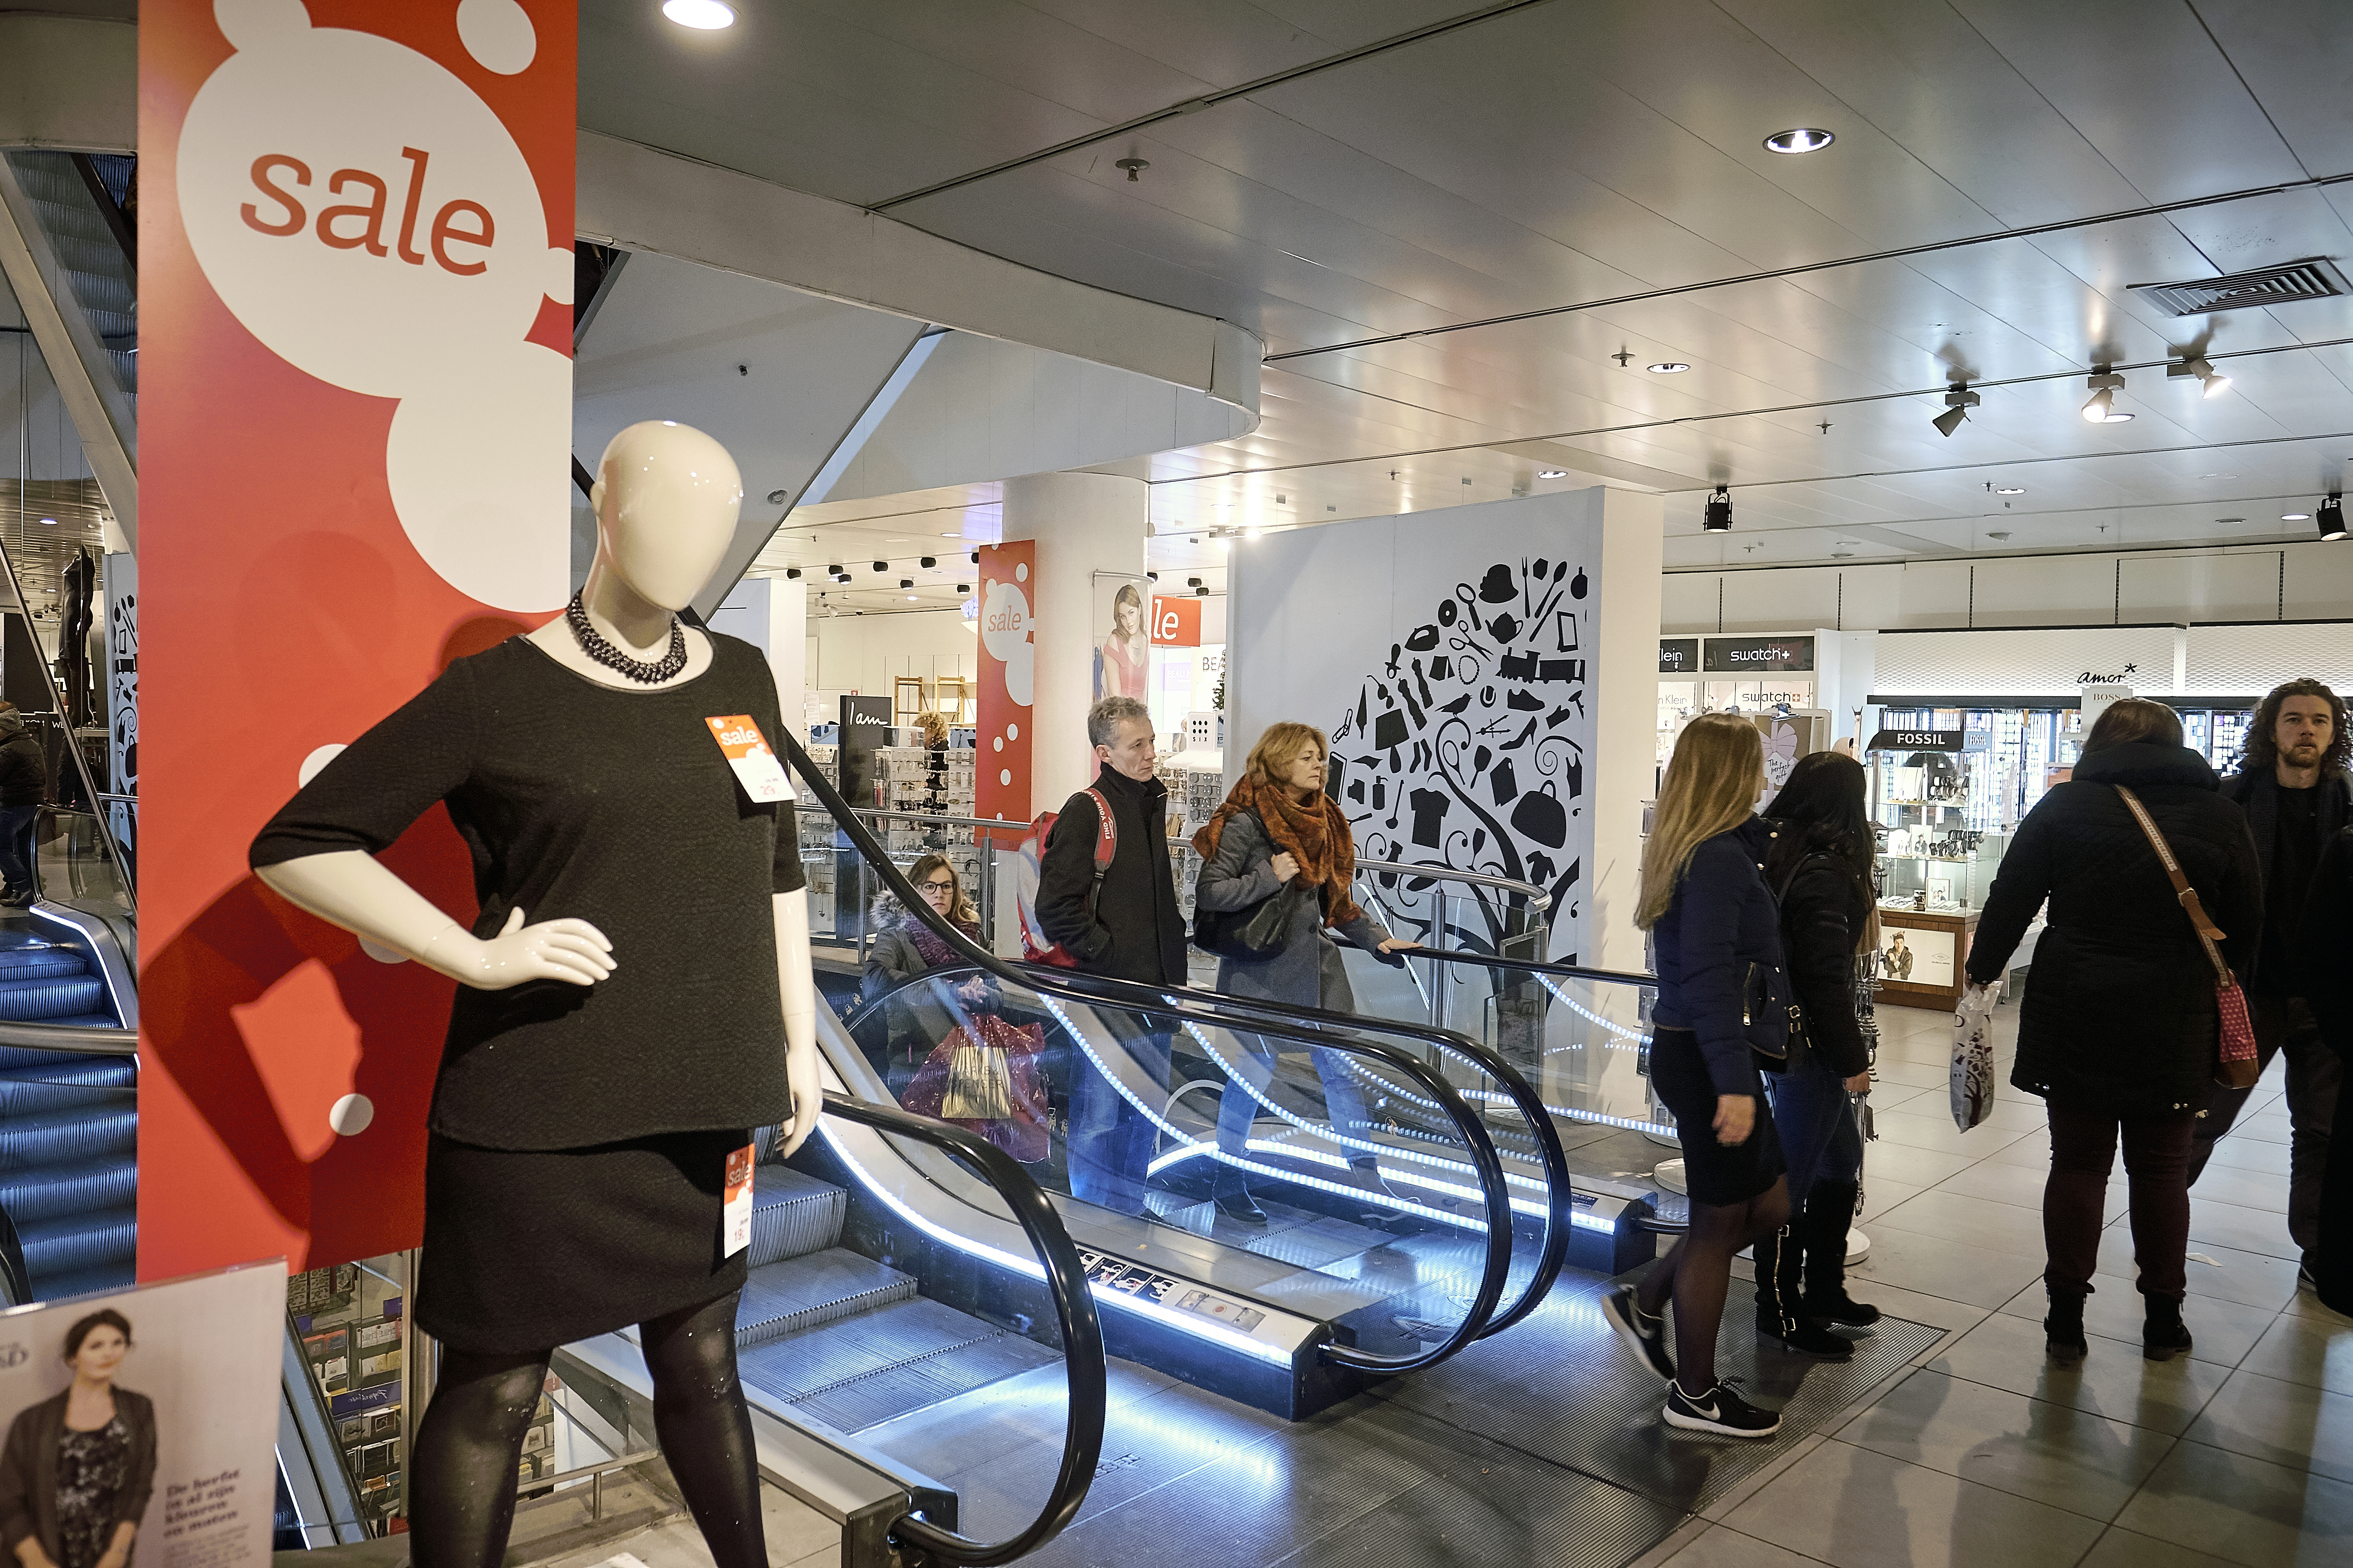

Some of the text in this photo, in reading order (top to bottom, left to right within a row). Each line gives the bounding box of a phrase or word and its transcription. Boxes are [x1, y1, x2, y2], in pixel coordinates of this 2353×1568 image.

[240, 145, 495, 276] sale
[988, 605, 1021, 632] sale
[1152, 598, 1179, 640] le
[1659, 648, 1682, 661] lein
[2077, 672, 2126, 683] amor
[1666, 694, 1687, 704] Klein
[1742, 692, 1791, 702] swatch
[720, 725, 759, 746] sale
[1897, 733, 1945, 745] FOSSIL
[1969, 734, 1987, 746] FOSSIL
[1771, 761, 1791, 775] perfect
[1775, 770, 1787, 783] gift
[1097, 802, 1106, 821] YOUR
[727, 1160, 752, 1187] sale
